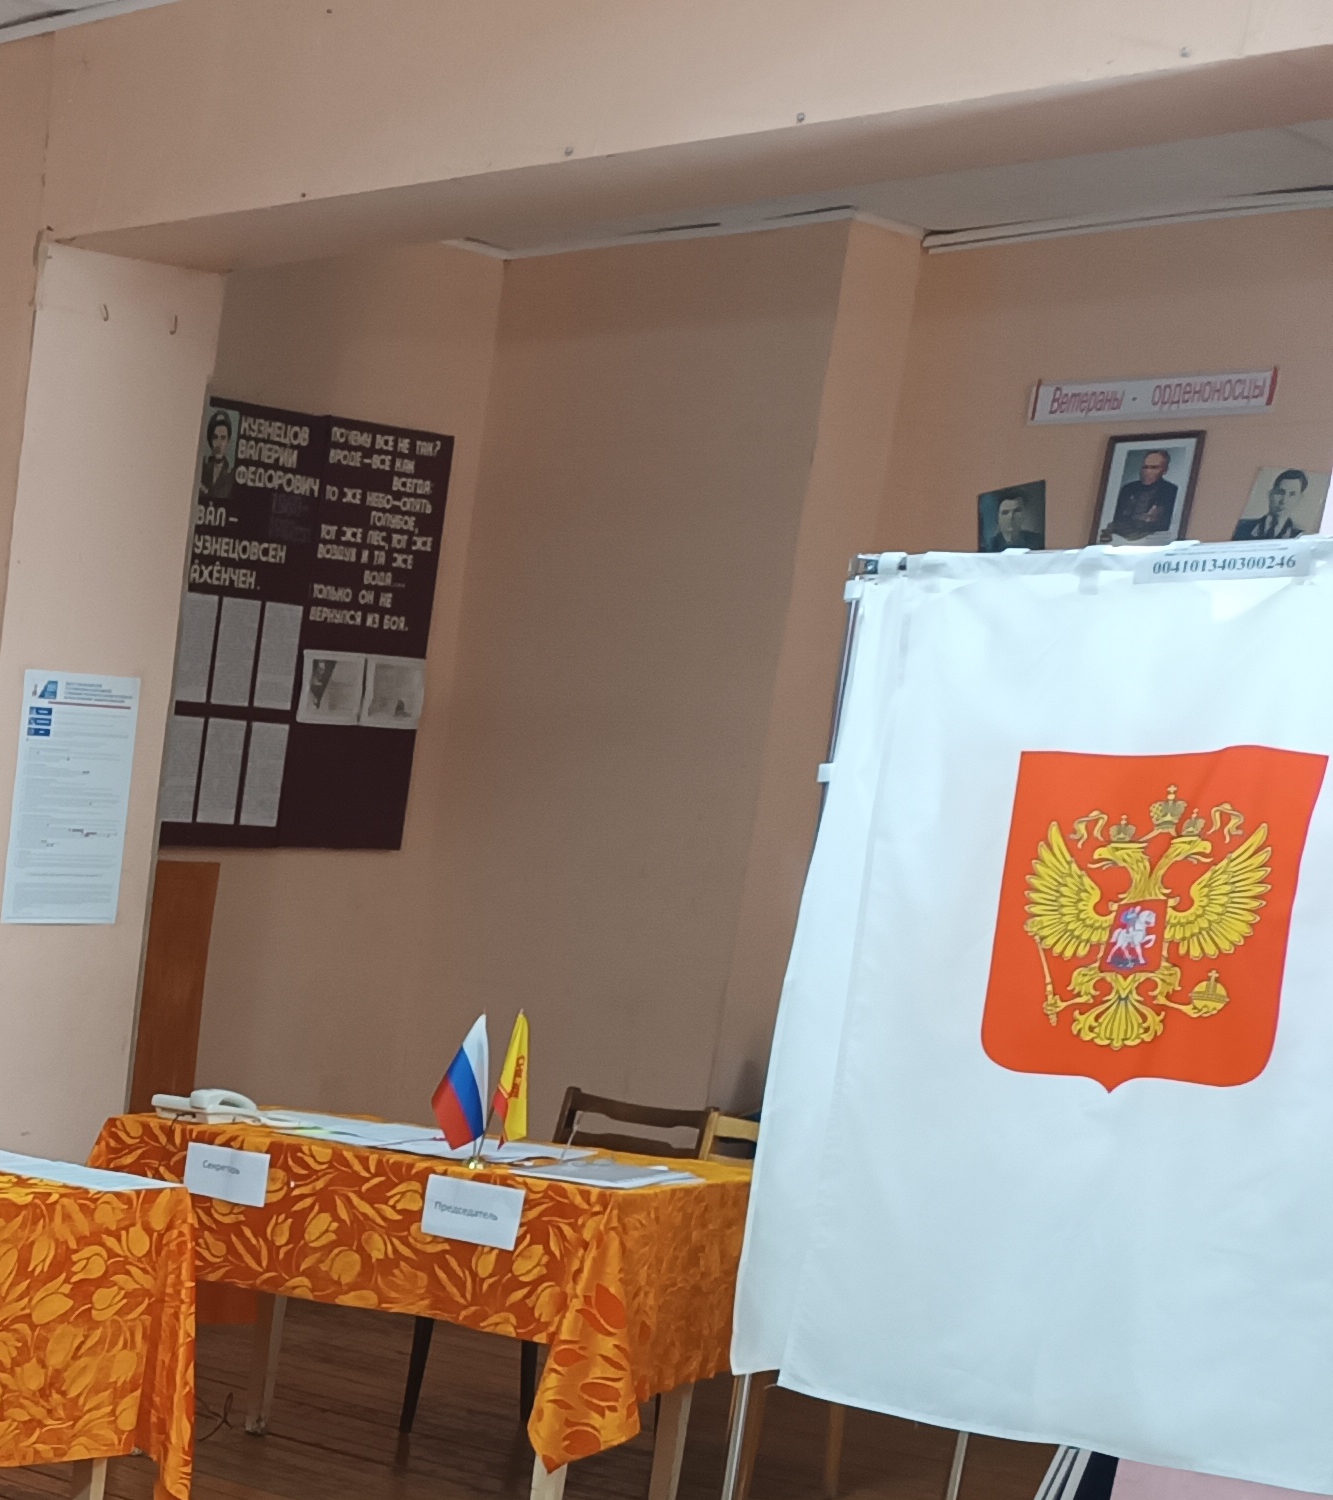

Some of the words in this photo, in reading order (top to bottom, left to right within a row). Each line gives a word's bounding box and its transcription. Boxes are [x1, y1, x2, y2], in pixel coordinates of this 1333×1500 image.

[1049, 386, 1125, 415] Ветераны
[1151, 377, 1268, 410] орденоносцы
[240, 415, 311, 447] КУЗНЕЦОВ
[375, 434, 395, 451] ВСЕ
[397, 437, 411, 454] НЕ
[235, 465, 321, 498] ФЕДОРОВИЧ
[325, 484, 339, 502] ТО
[342, 487, 363, 505] ЖЕ
[320, 523, 338, 540] ТОТ
[341, 526, 363, 543] ЖЕ
[391, 533, 409, 549] ТОТ
[411, 536, 433, 552] ЖЕ
[194, 534, 287, 564] УЗНЕЦОВСЕН
[391, 552, 414, 570] ЖЕ
[1152, 555, 1297, 575] 004101340300246
[358, 589, 375, 605] ОН
[383, 614, 409, 632] БОЯ.
[434, 1200, 499, 1221] Председатель
